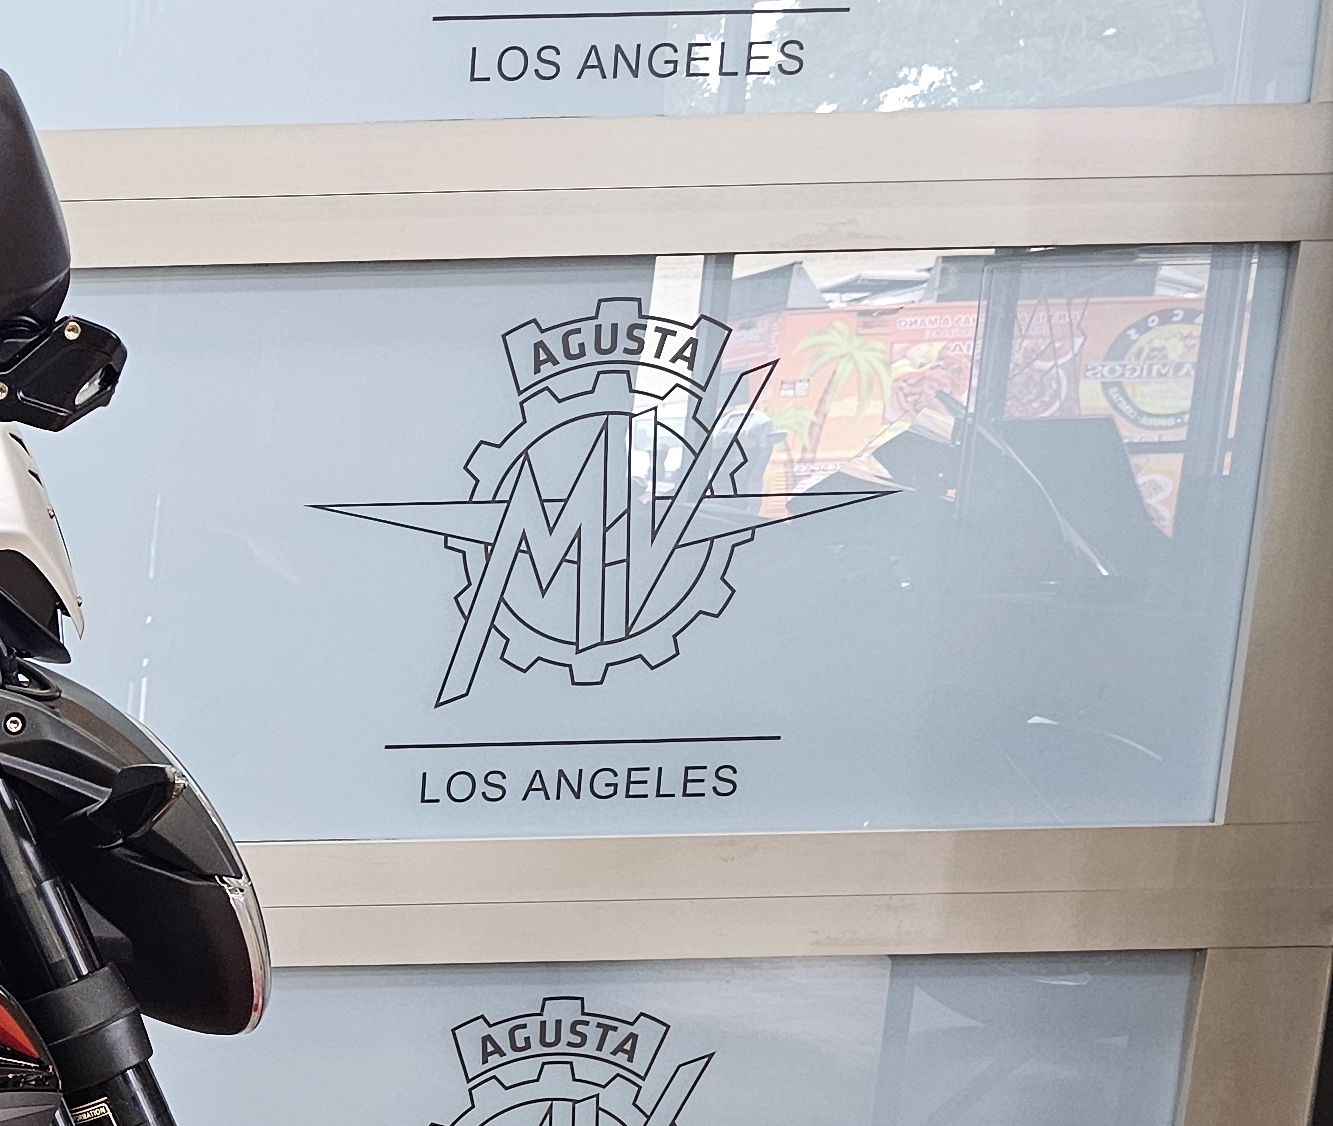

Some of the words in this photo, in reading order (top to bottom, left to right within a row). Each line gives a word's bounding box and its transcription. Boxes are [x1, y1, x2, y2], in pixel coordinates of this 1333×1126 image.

[470, 45, 560, 81] LOS
[577, 39, 803, 79] ANGELES
[533, 323, 699, 374] AGUSTA
[421, 770, 506, 803] LOS
[522, 764, 737, 801] ANGELES
[481, 1018, 639, 1064] AGUSTA
